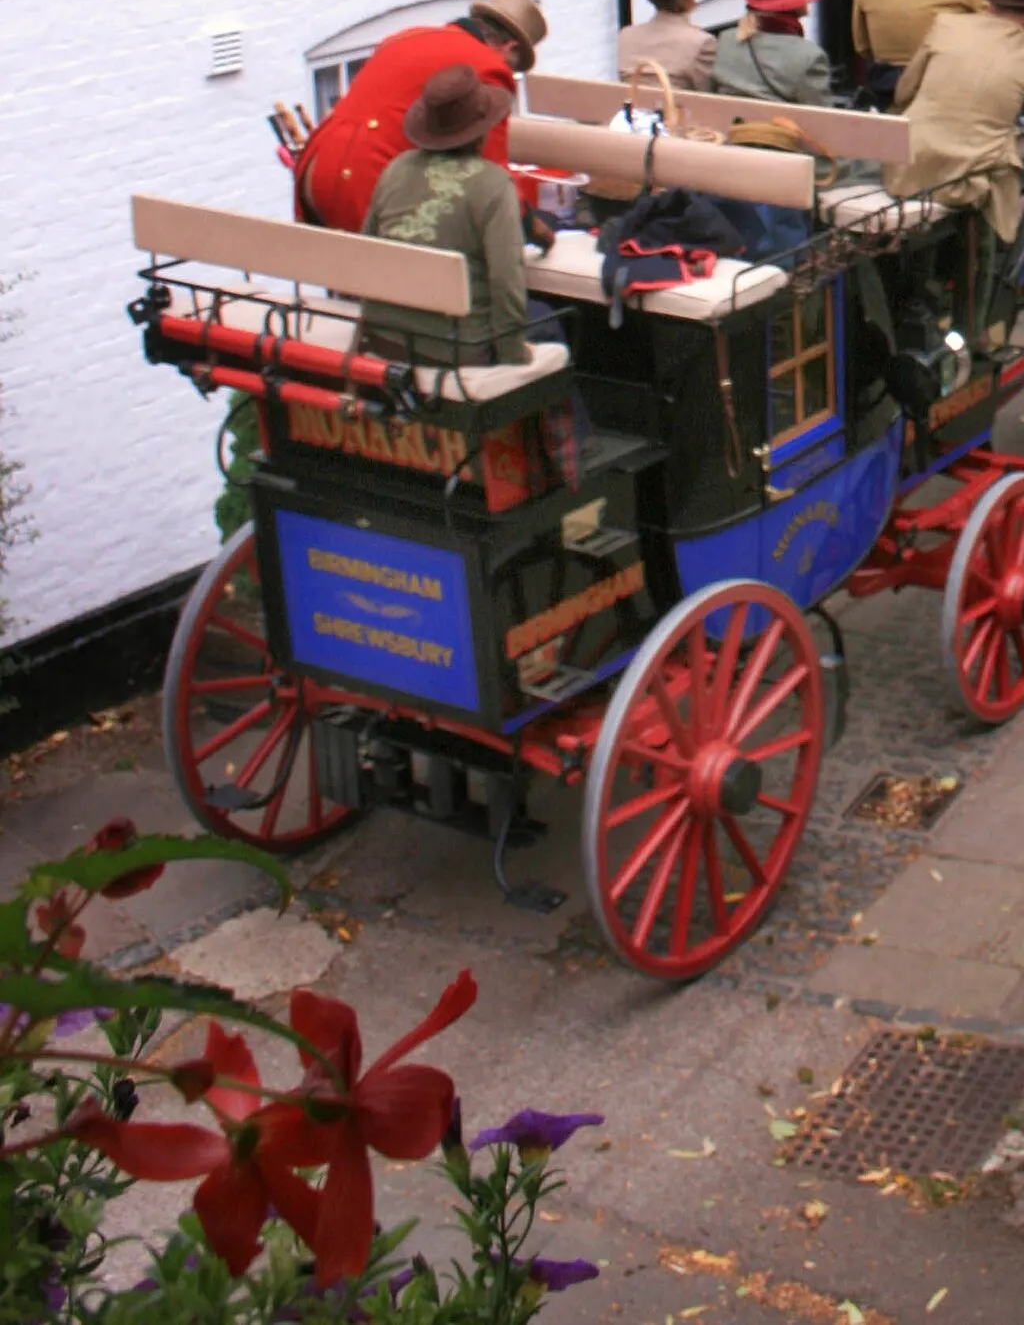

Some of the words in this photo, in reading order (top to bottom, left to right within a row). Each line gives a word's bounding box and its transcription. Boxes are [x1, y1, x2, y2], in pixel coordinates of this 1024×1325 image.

[288, 401, 473, 482] MONARCH
[307, 547, 443, 601] BIRMINGHAM
[313, 611, 454, 668] SHREWSBURY
